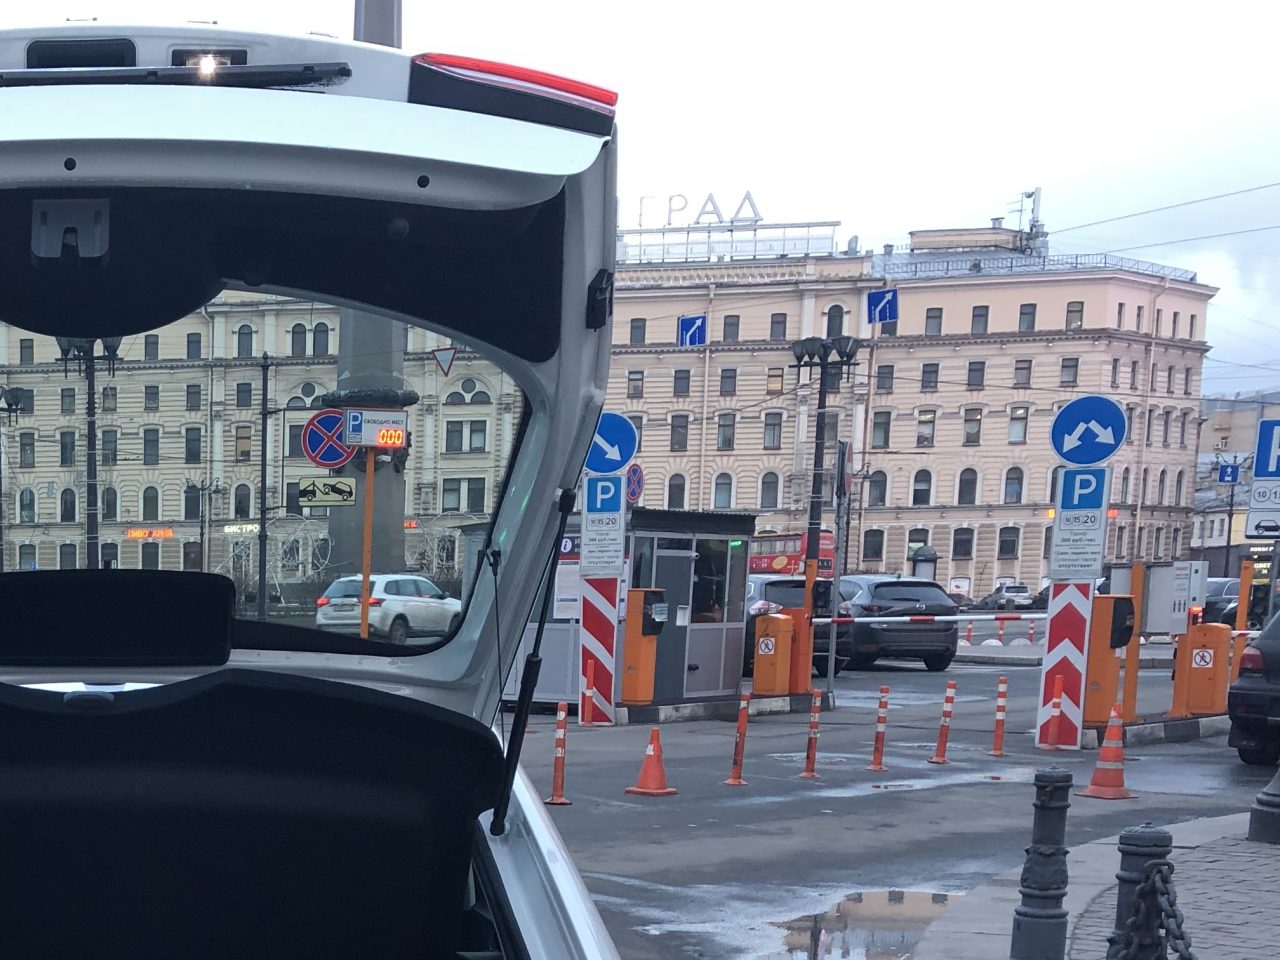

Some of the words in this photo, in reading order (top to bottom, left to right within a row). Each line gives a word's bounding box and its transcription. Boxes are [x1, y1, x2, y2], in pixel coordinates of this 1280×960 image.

[350, 413, 361, 432] P
[379, 430, 403, 444] 000
[596, 481, 615, 509] P
[1073, 474, 1097, 505] P
[1257, 490, 1267, 498] 10
[1083, 515, 1096, 524] 20
[224, 524, 260, 532] БИСТРО
